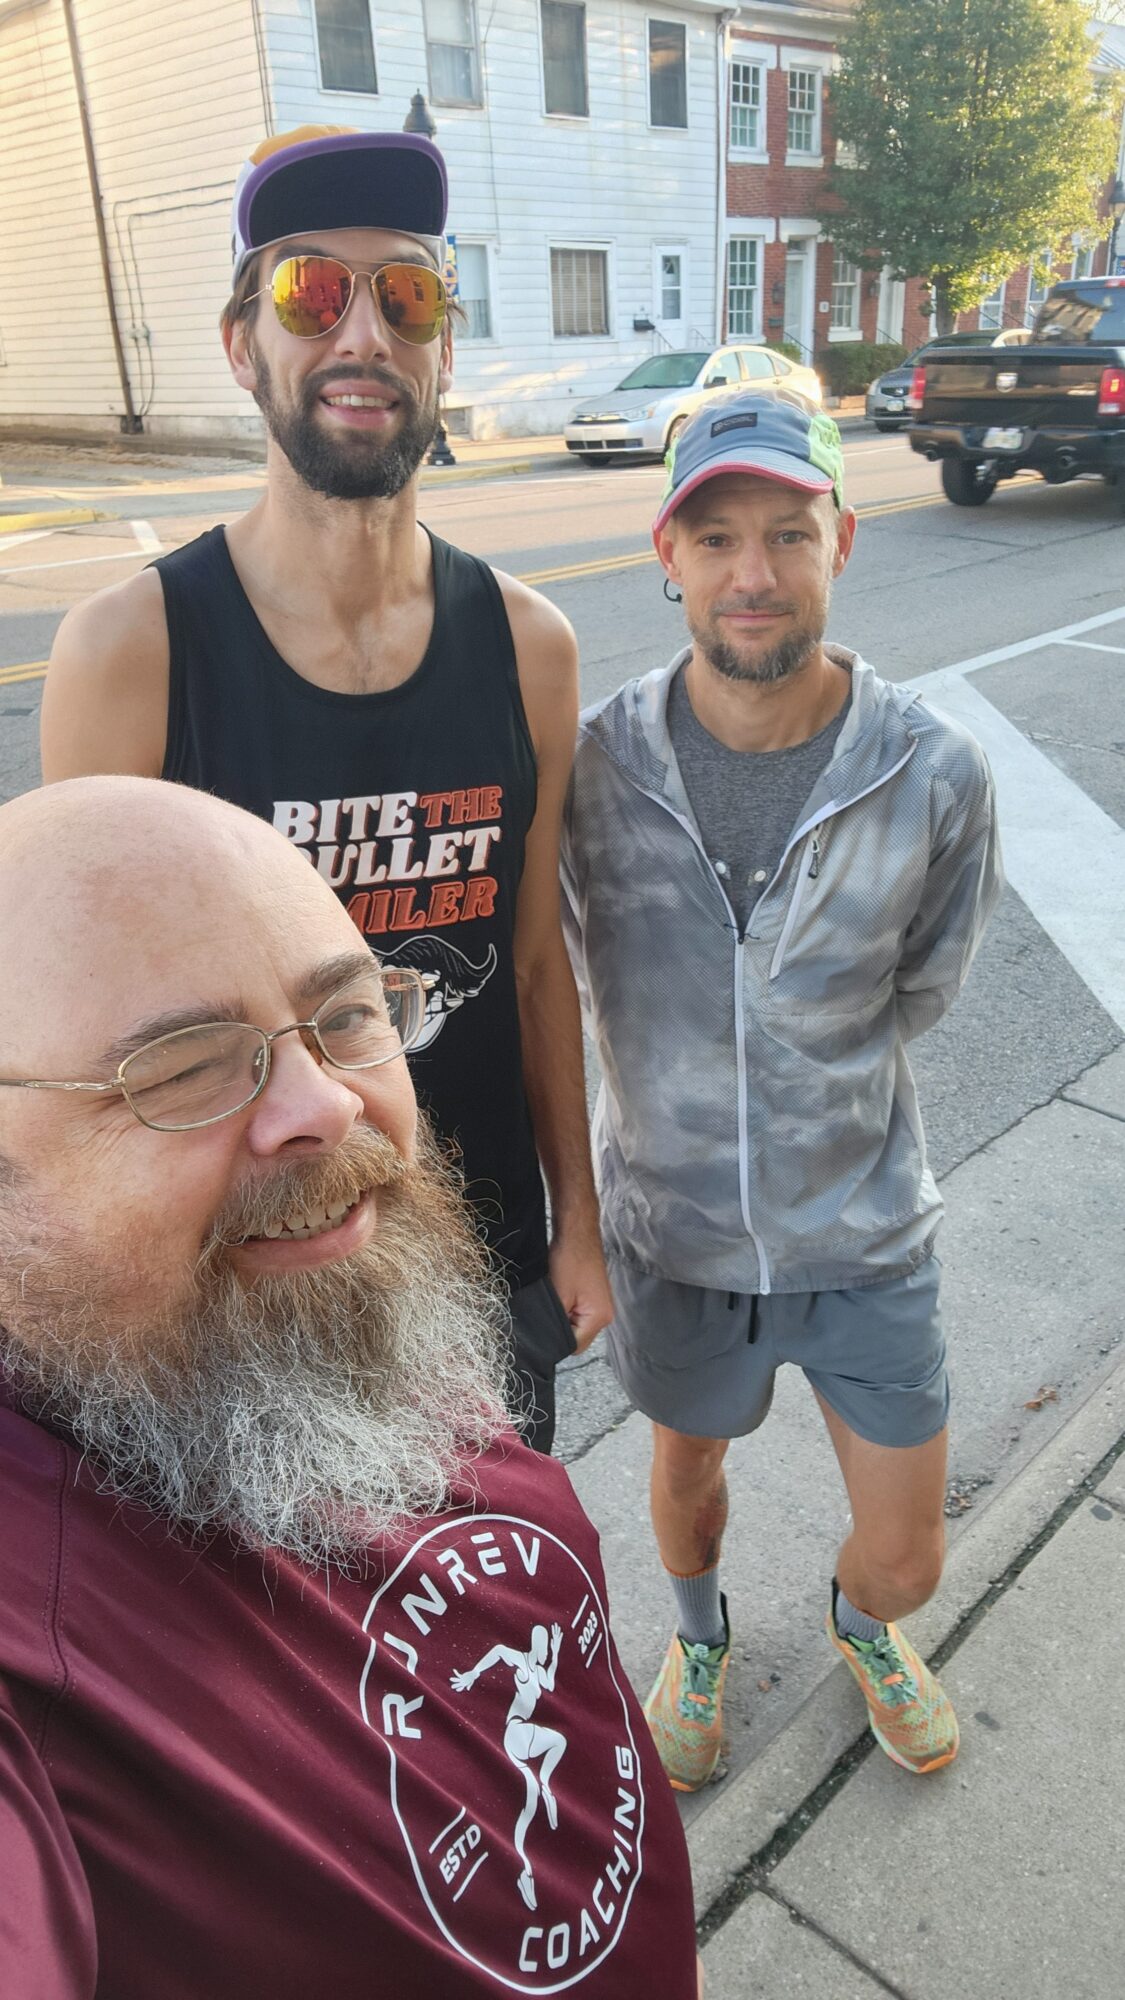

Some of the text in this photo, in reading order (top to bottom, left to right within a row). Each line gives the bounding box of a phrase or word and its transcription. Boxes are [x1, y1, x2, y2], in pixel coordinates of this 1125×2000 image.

[273, 785, 502, 844] BITE THE
[297, 826, 501, 888] ULLET
[578, 1611, 598, 1655] 2023
[439, 1824, 482, 1884] ESTD
[518, 1745, 636, 1972] COACHING
